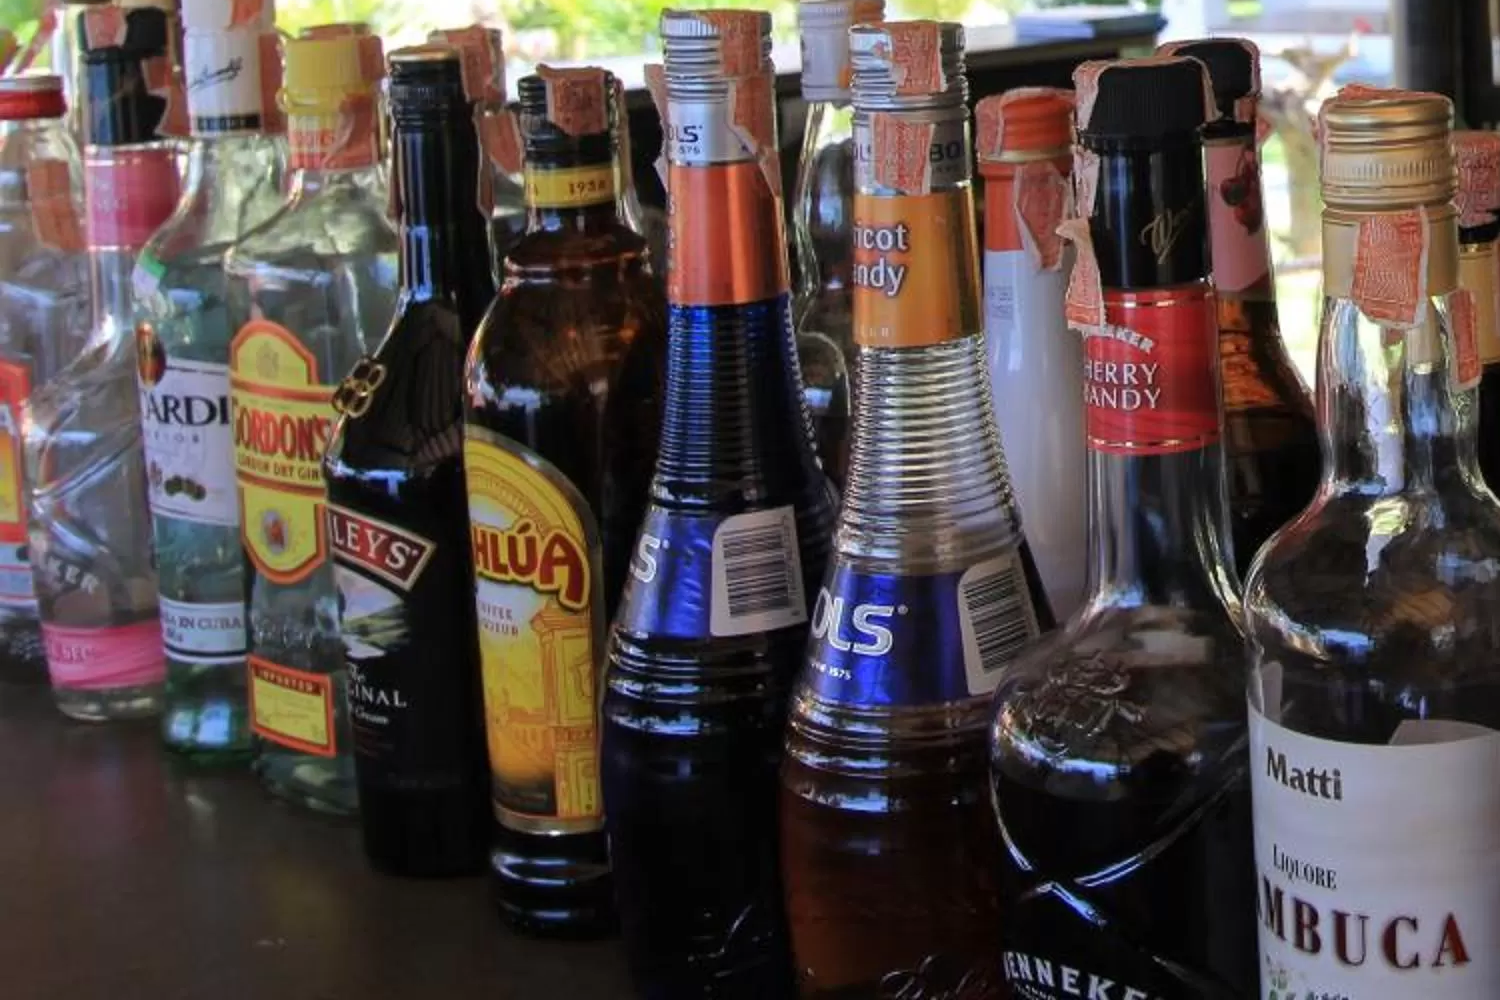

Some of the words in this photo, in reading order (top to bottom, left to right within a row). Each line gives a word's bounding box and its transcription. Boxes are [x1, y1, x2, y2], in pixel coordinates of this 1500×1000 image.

[234, 404, 333, 462] ORDON'S
[331, 515, 408, 571] LEYS
[1265, 746, 1344, 802] Matti
[1272, 843, 1338, 891] LIQUORE
[1257, 874, 1473, 970] MBUCA
